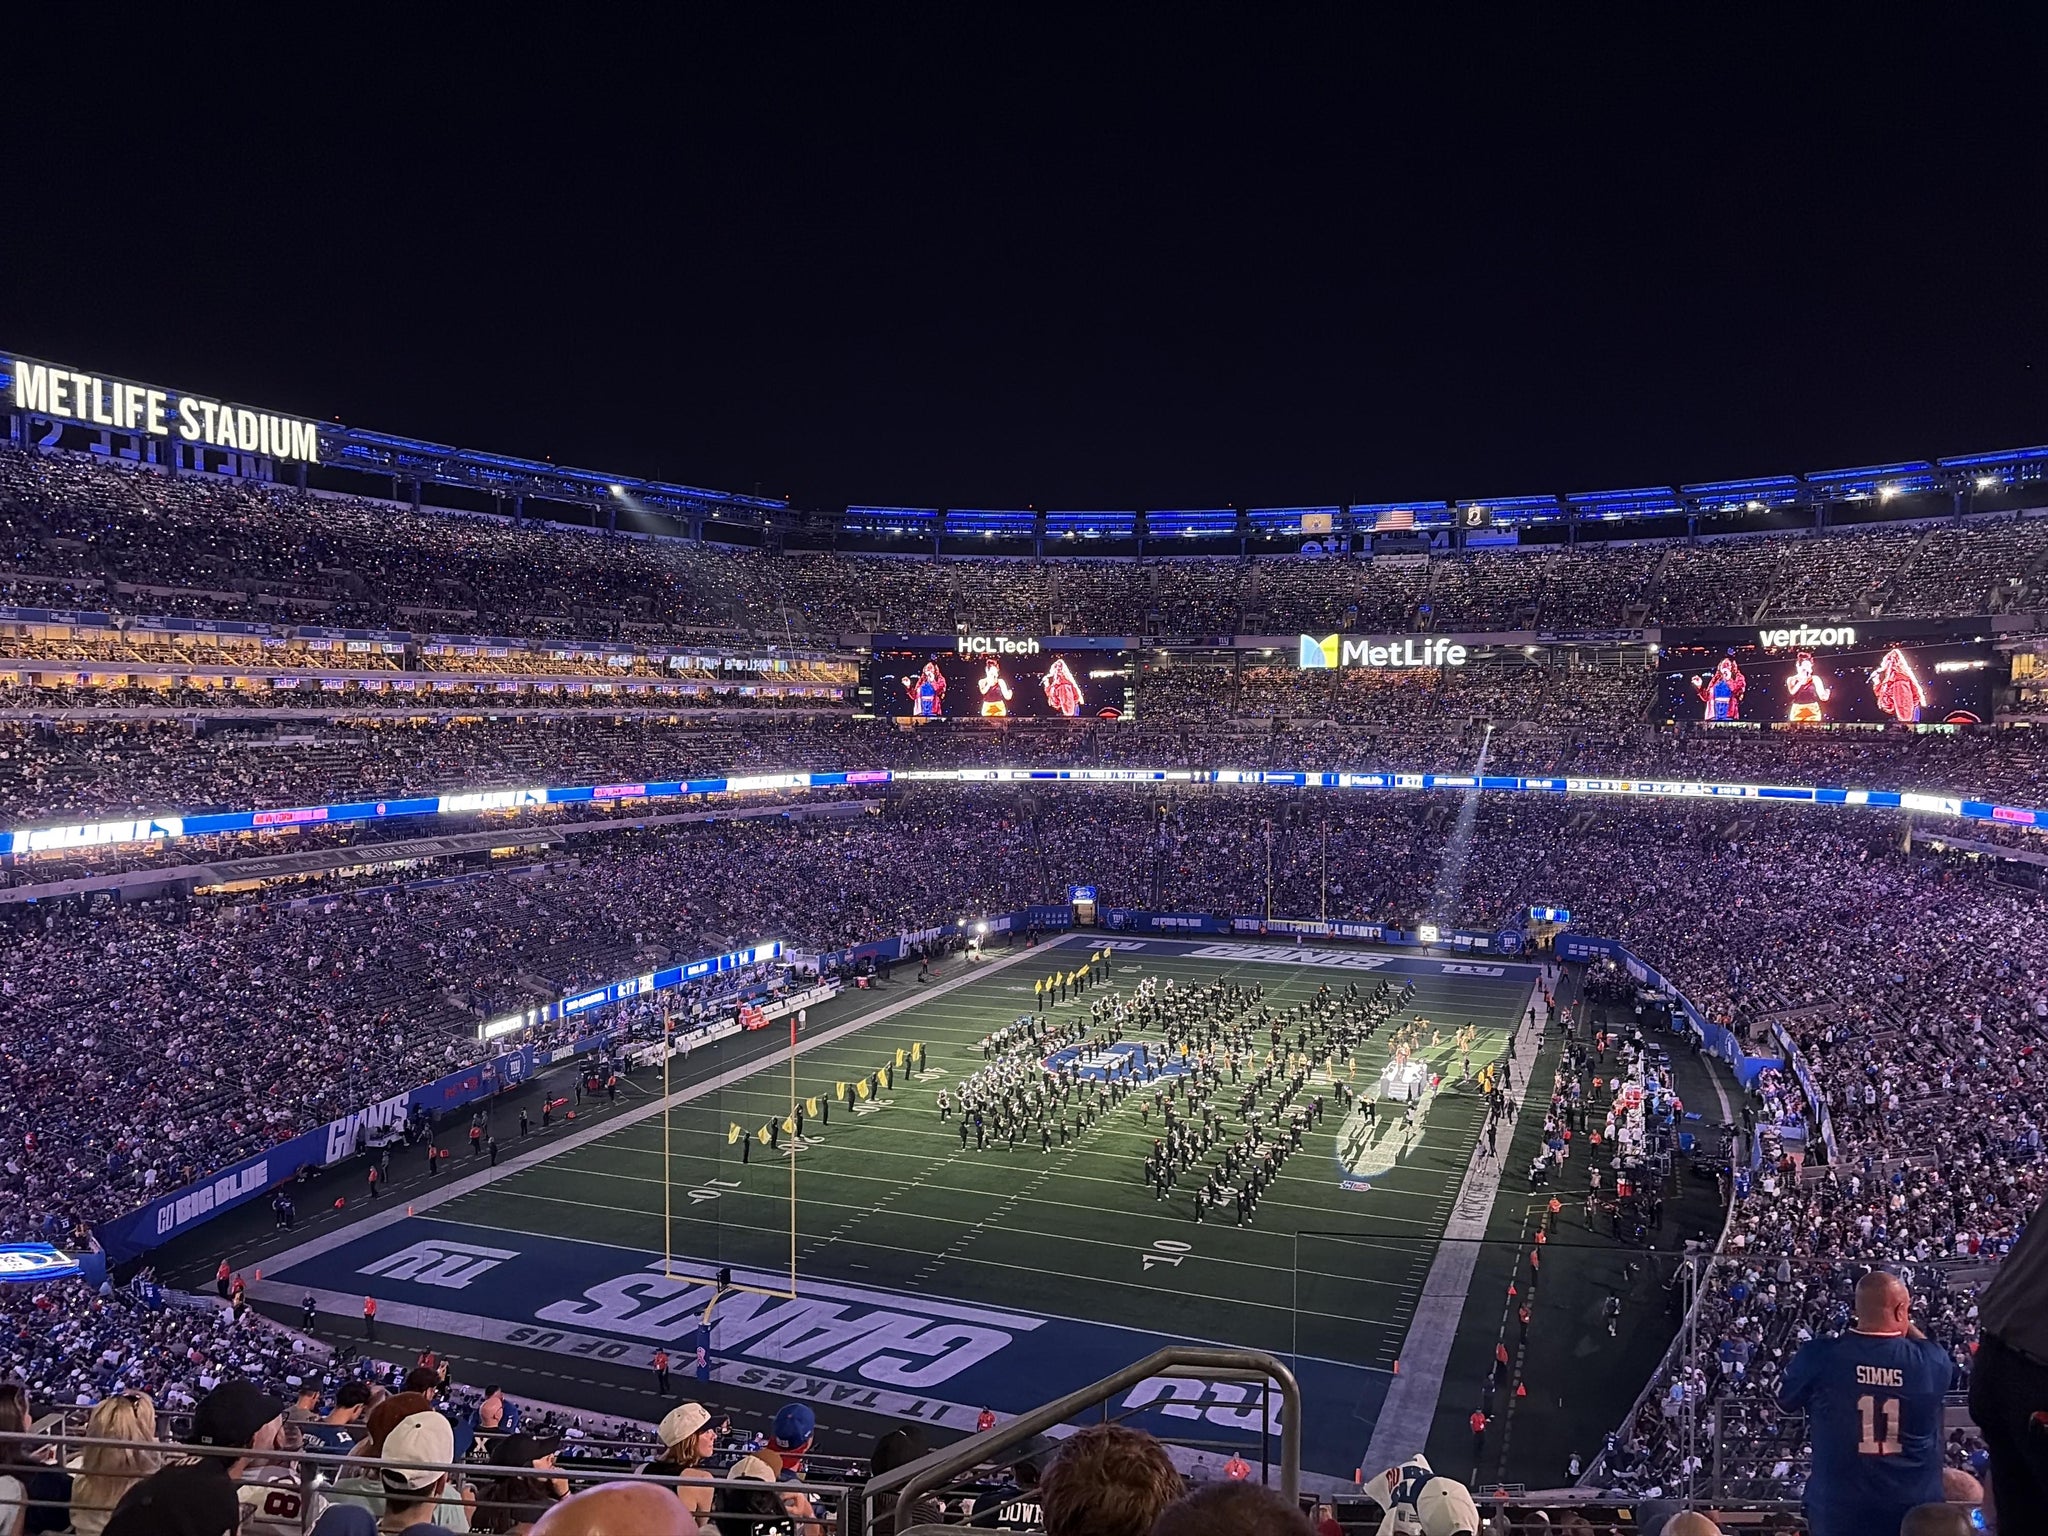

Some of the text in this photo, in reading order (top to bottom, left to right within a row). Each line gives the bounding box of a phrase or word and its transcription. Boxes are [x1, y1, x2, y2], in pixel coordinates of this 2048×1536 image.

[16, 361, 168, 435] METLIFE
[178, 397, 318, 463] STADIUM
[958, 637, 1040, 654] HCLTech
[1760, 625, 1855, 647] verizon
[1342, 637, 1467, 667] MetLife
[357, 842, 445, 859] METLIFE STADIUM
[238, 862, 280, 873] MetLife
[1234, 918, 1260, 930] NEW
[1342, 924, 1382, 938] GIANTS
[1190, 945, 1395, 970] GIANTS
[551, 1044, 575, 1062] GIANTS
[157, 1160, 268, 1234] GO BIG BLUE
[1142, 1240, 1192, 1267] 10
[534, 1259, 1048, 1388] GIANTS
[506, 1327, 568, 1348] US
[570, 1340, 630, 1359] OF
[1856, 1365, 1904, 1387] SIMMS
[736, 1368, 895, 1409] TAKES
[899, 1401, 956, 1422] IT
[1857, 1395, 1903, 1455] 11
